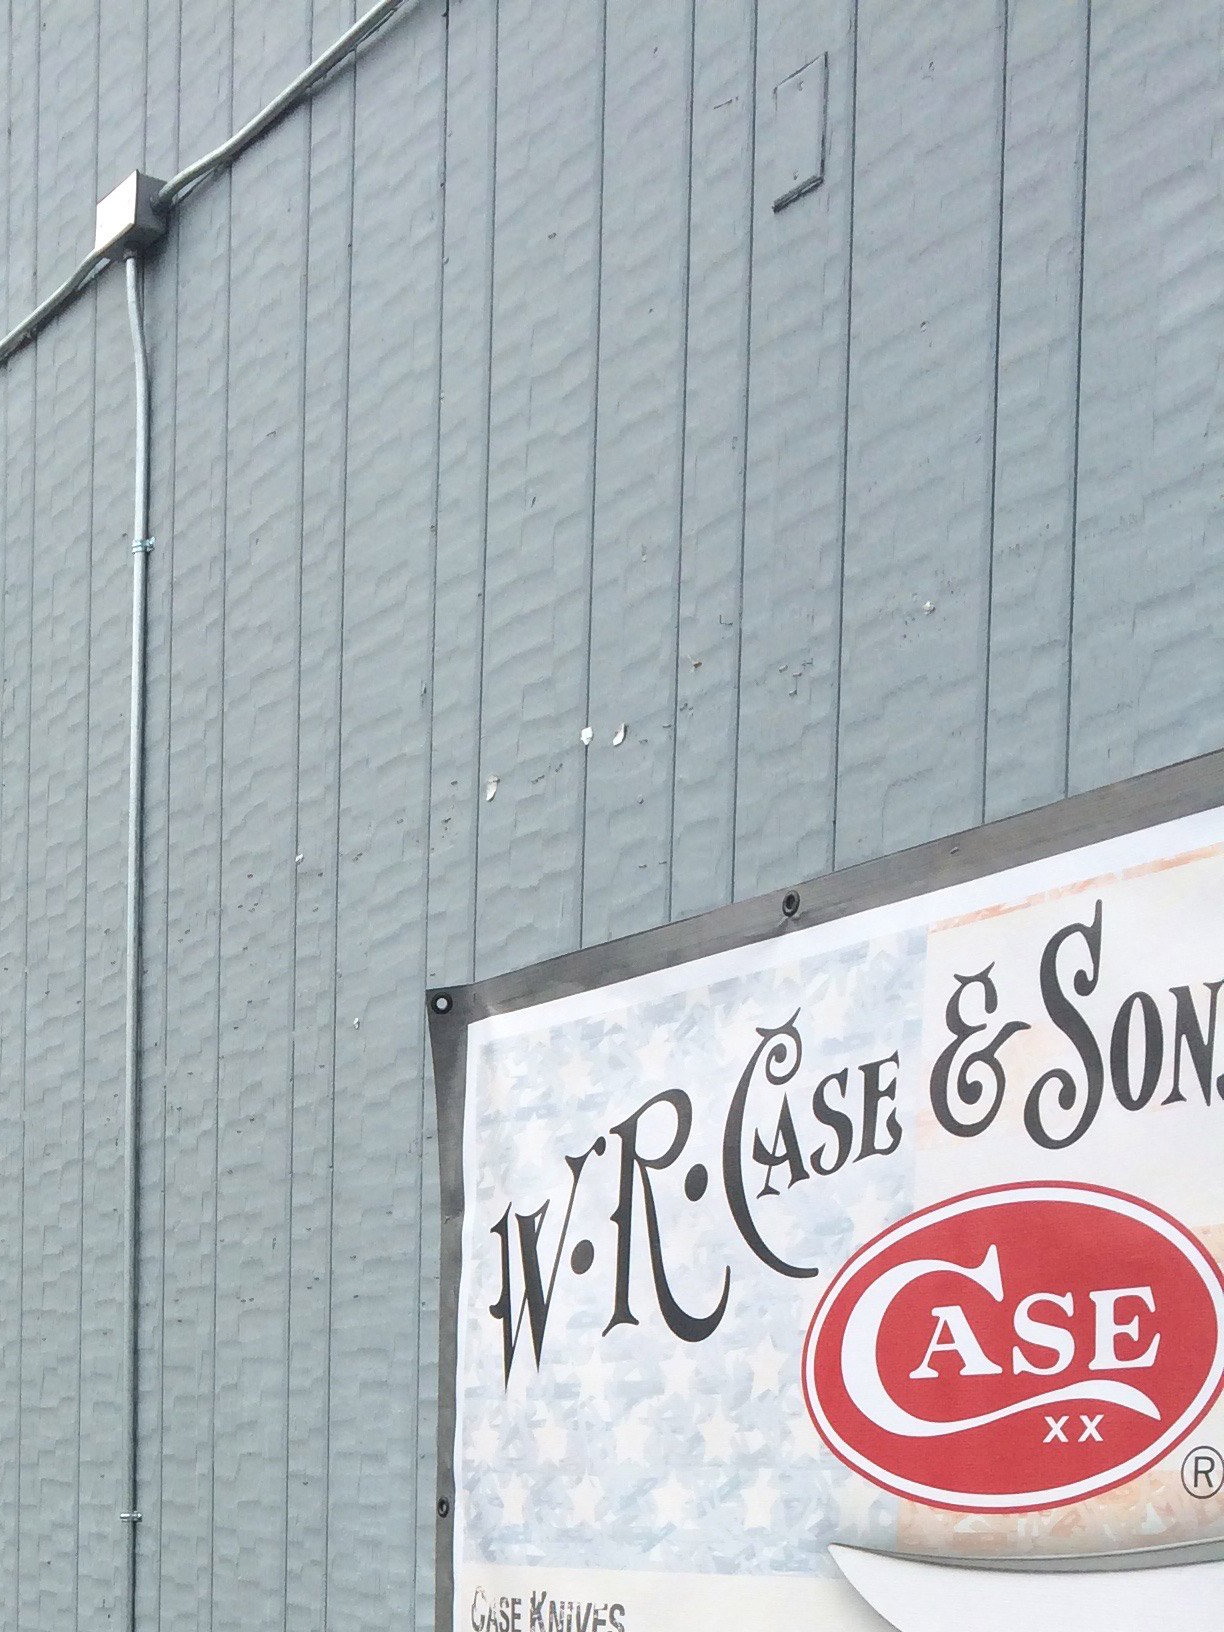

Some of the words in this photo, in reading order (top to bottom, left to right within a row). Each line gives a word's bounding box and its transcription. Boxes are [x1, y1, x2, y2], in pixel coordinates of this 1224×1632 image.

[929, 962, 1030, 1138] &
[1024, 899, 1224, 1149] SON
[841, 1244, 1162, 1438] CASE
